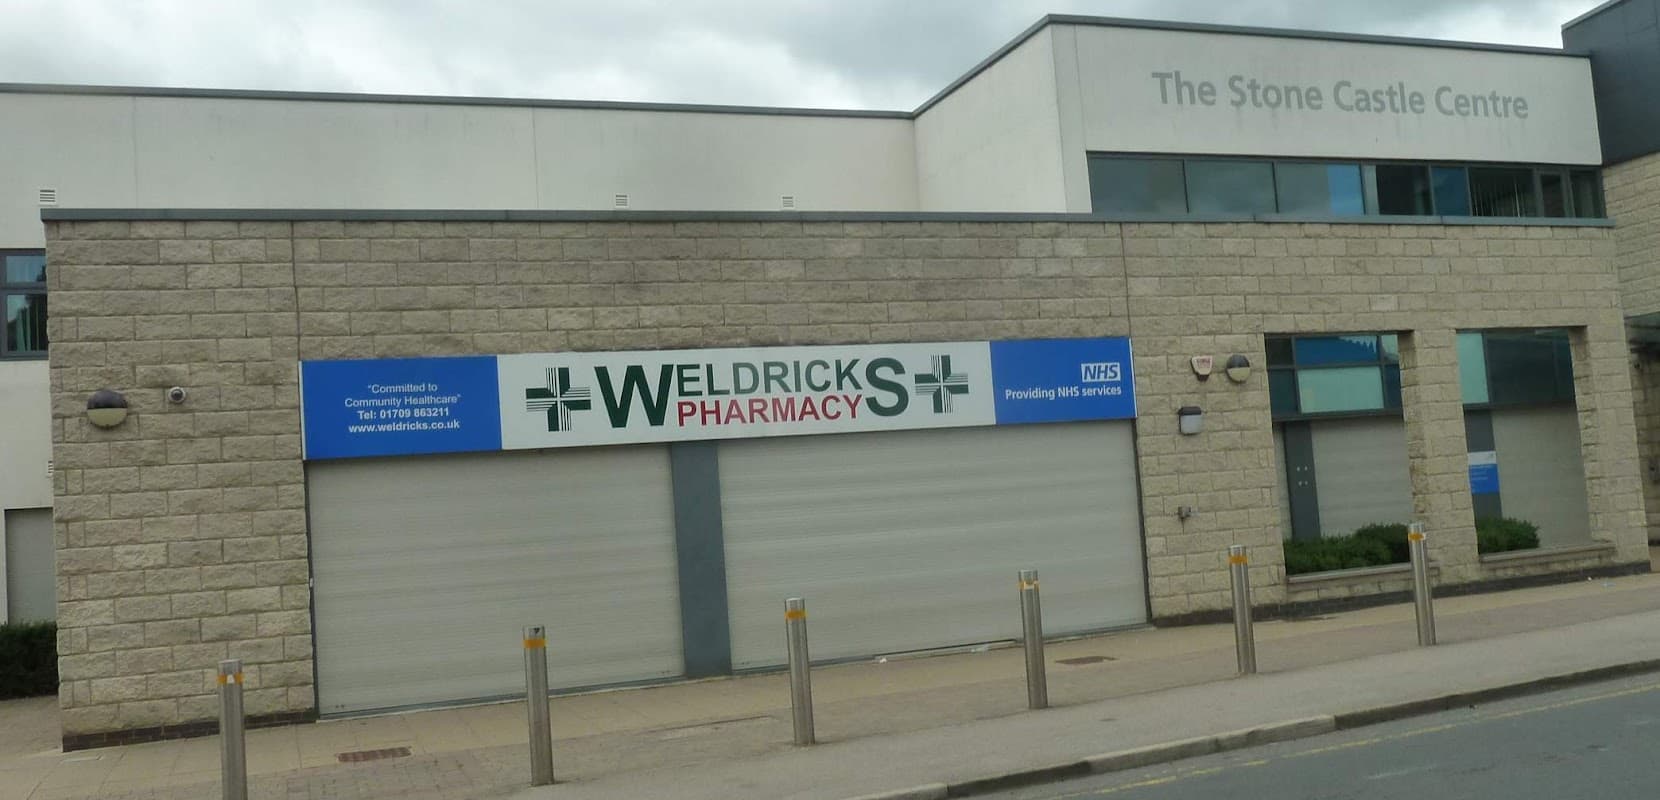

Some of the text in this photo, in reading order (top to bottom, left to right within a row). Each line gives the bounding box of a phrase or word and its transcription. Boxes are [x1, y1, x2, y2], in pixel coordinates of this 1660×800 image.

[1152, 71, 1529, 120] The Stone Castle Centre
[1083, 363, 1119, 381] NHS
[427, 382, 438, 393] to
[594, 357, 909, 430] WELDRICKS
[1005, 384, 1122, 401] Providing NHS services
[344, 397, 402, 409] Community
[677, 393, 863, 428] PHARMACY
[357, 407, 450, 420] Tel: 01709 863211
[348, 419, 461, 434] www.weldricks.co.uk
